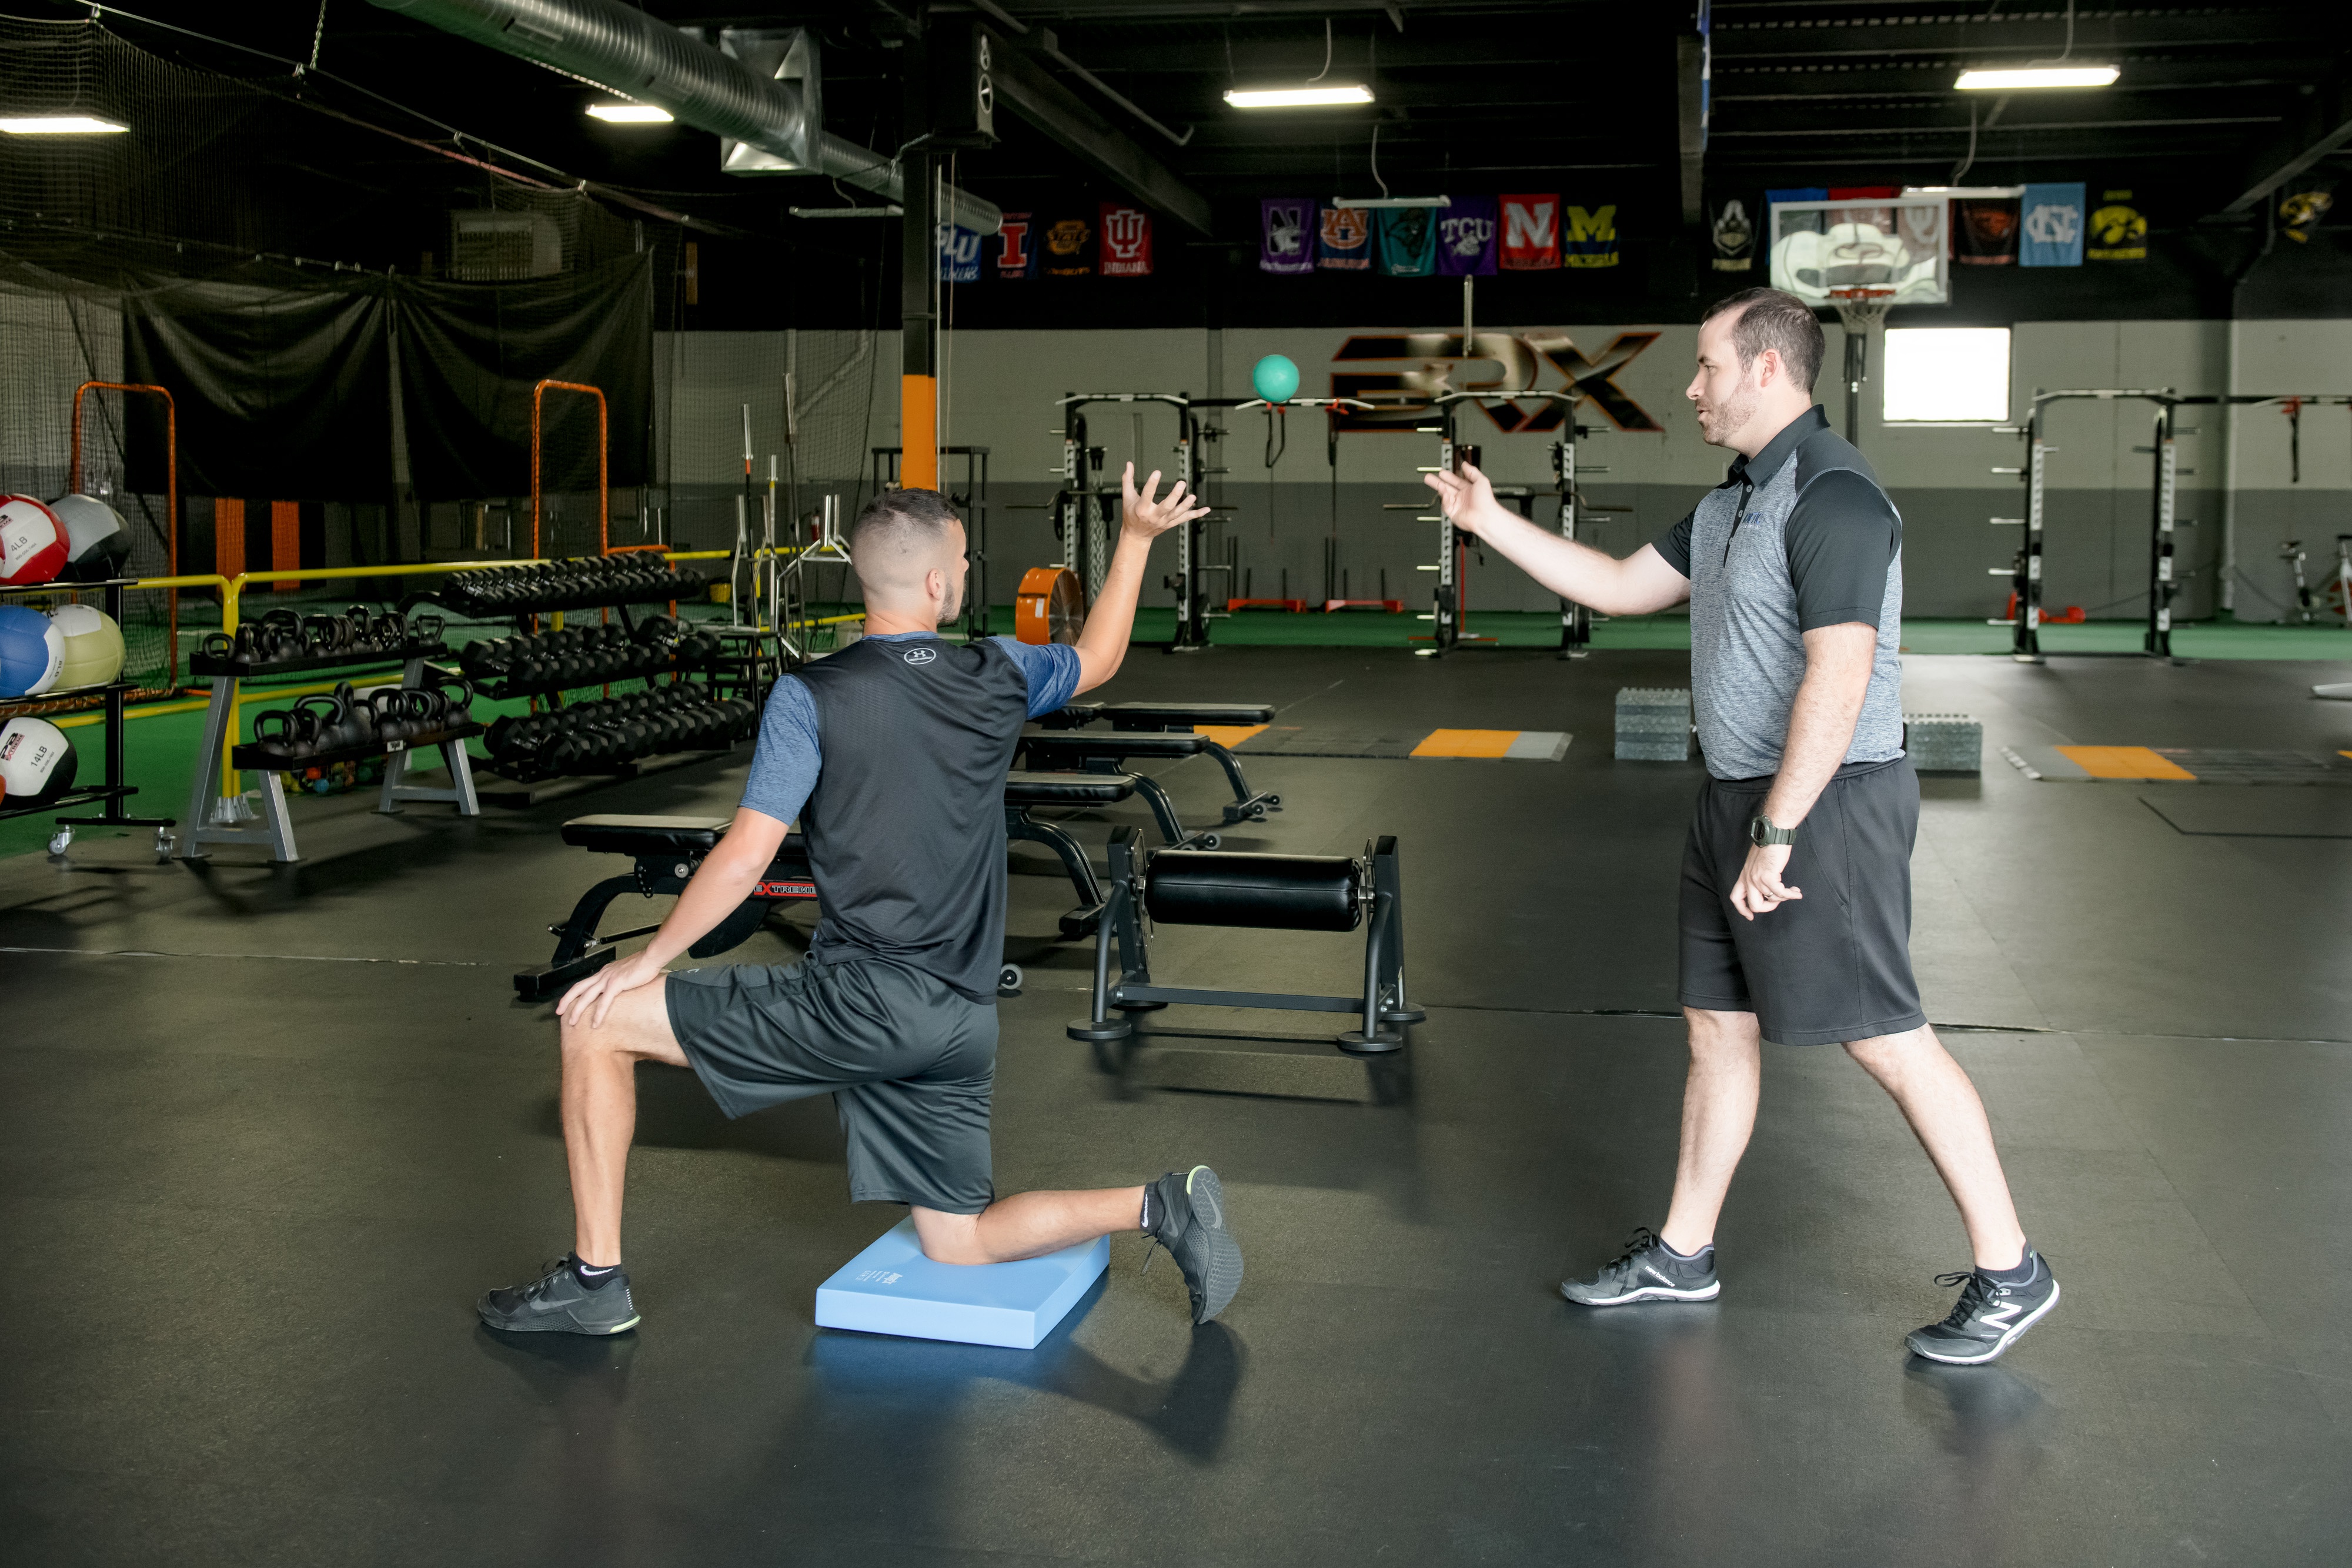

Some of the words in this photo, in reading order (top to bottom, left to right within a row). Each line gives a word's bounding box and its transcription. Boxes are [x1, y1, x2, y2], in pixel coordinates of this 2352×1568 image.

[1440, 216, 1494, 243] TCU
[11, 536, 28, 551] 4LB
[31, 745, 47, 767] 14LB
[1655, 1272, 1675, 1287] balance
